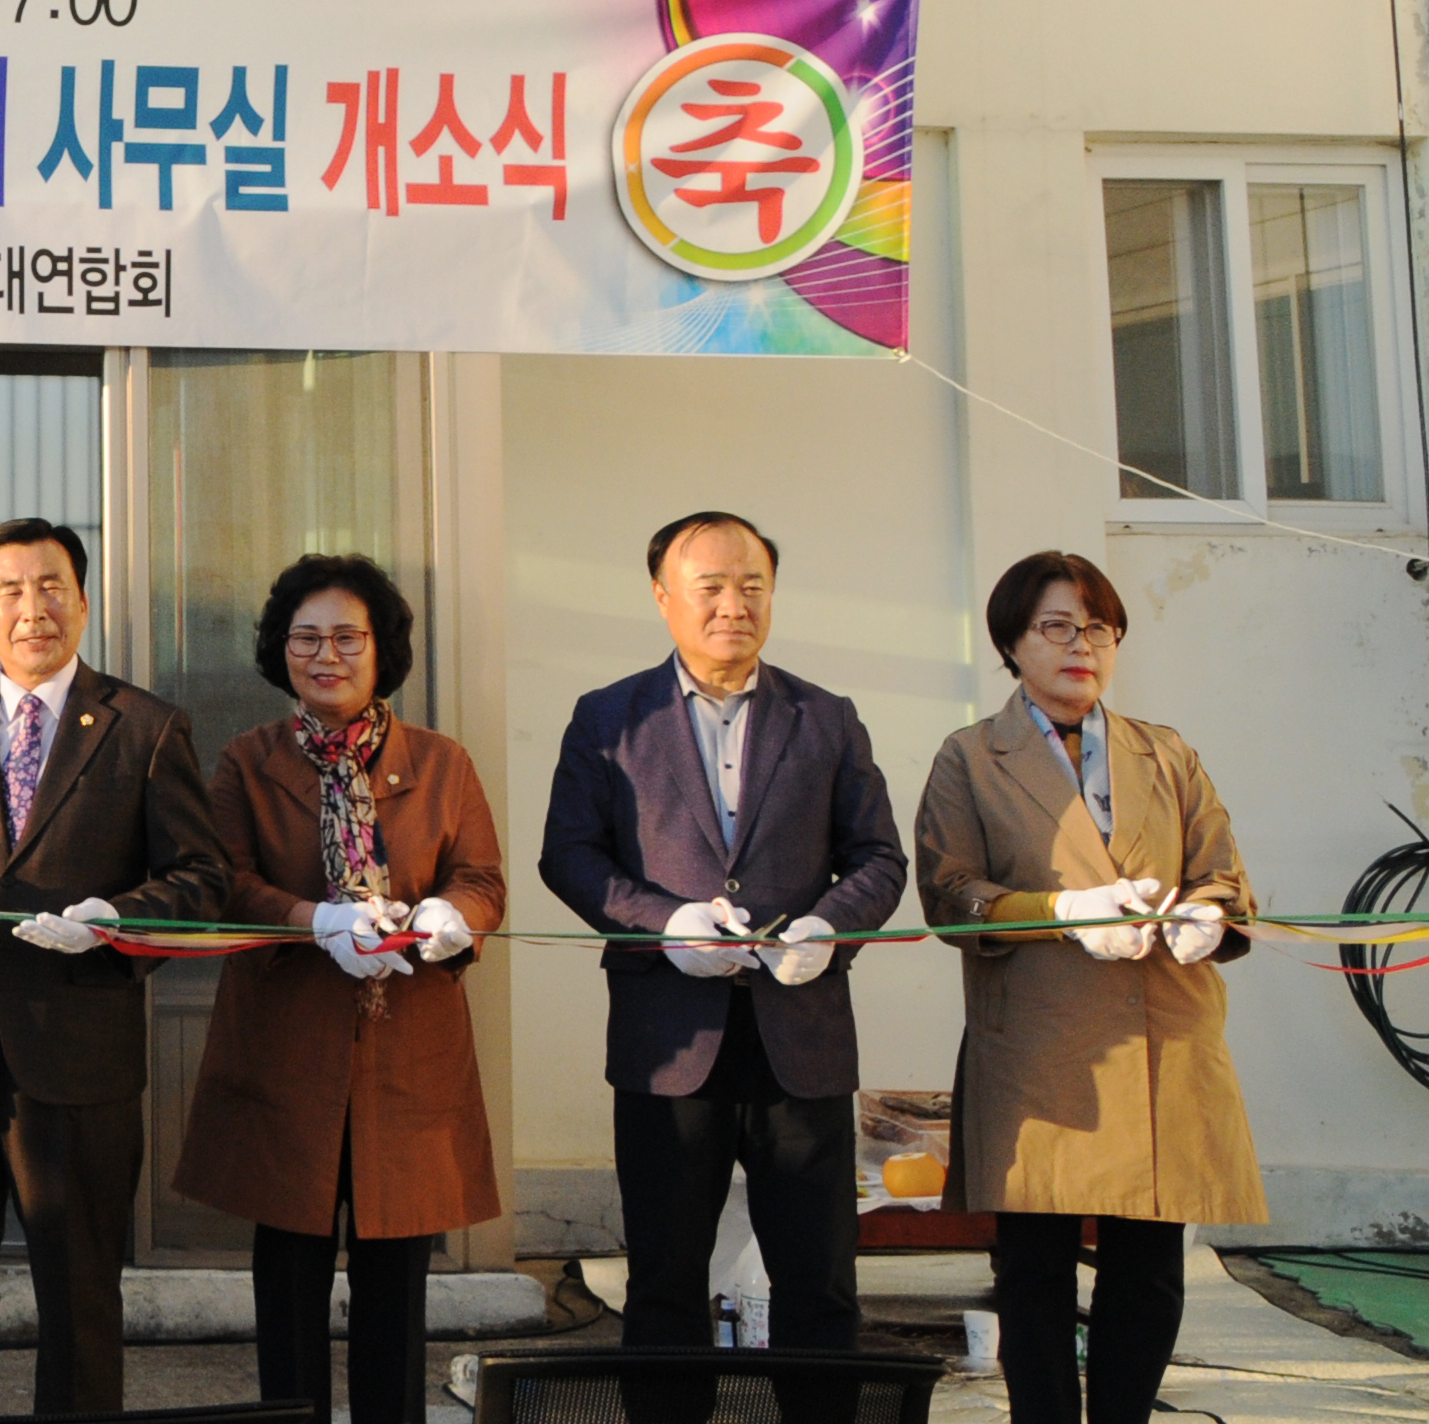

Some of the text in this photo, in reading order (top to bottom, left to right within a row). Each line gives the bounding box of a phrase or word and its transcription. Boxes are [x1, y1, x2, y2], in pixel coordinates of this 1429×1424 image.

[37, 58, 290, 213] 사무실
[320, 66, 570, 222] 개소식
[650, 77, 821, 246] 축
